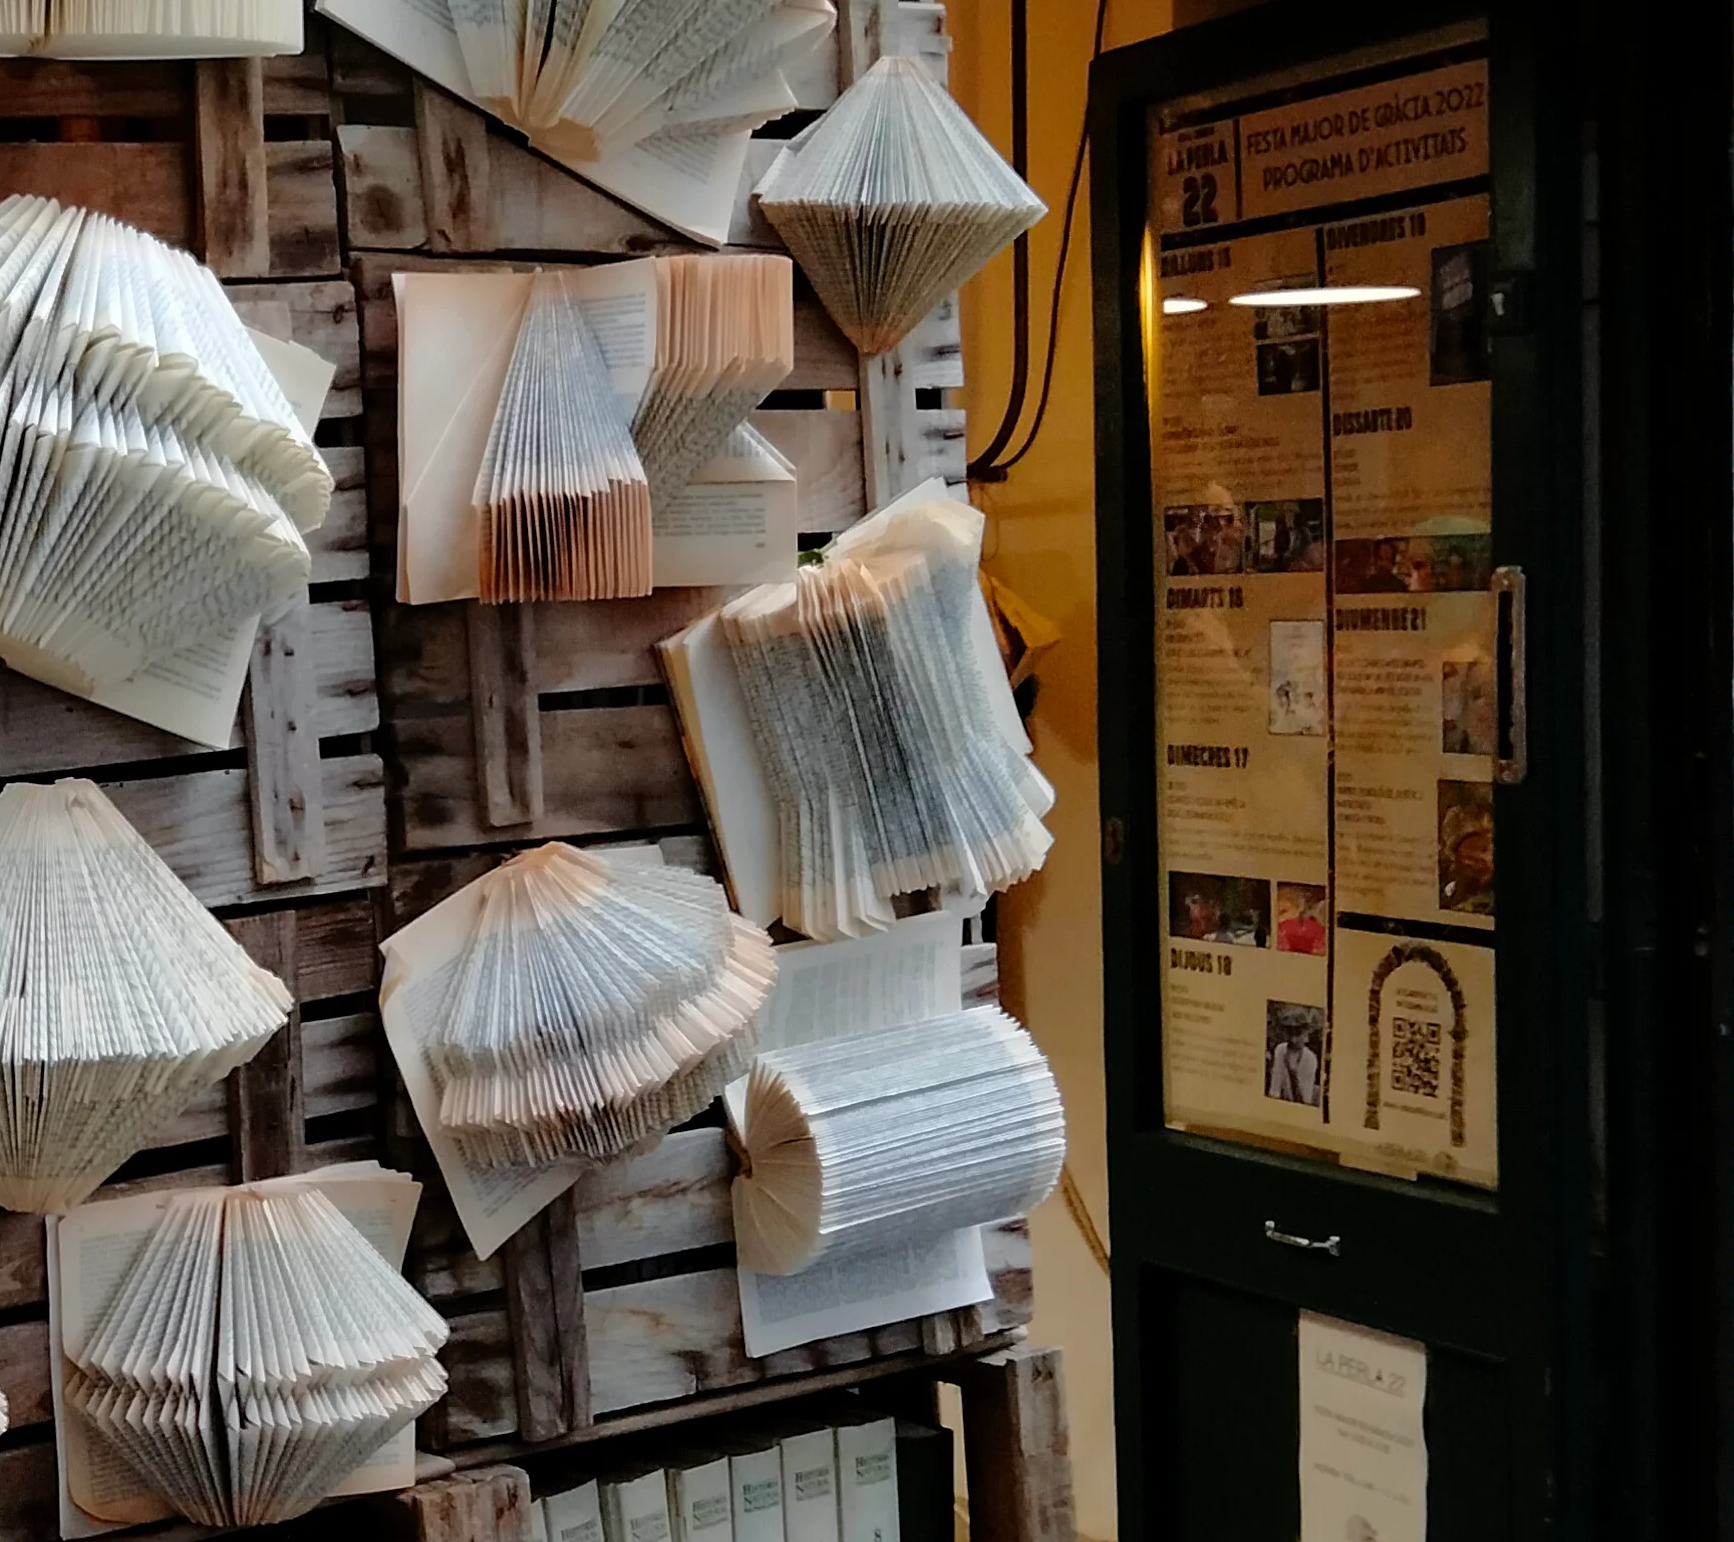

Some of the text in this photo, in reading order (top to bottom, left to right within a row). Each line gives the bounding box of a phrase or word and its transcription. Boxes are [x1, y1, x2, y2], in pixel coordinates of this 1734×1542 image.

[1247, 128, 1287, 157] FESTA
[1290, 116, 1344, 148] MAJOR
[1349, 109, 1370, 135] DE
[1375, 94, 1431, 127] GRÀCIA
[1435, 82, 1484, 116] 2022
[1263, 150, 1354, 192] PROGRAMA
[1182, 172, 1218, 227] 22
[1171, 948, 1214, 975] DIJOUS
[1317, 1347, 1406, 1390] LA PERLA 22
